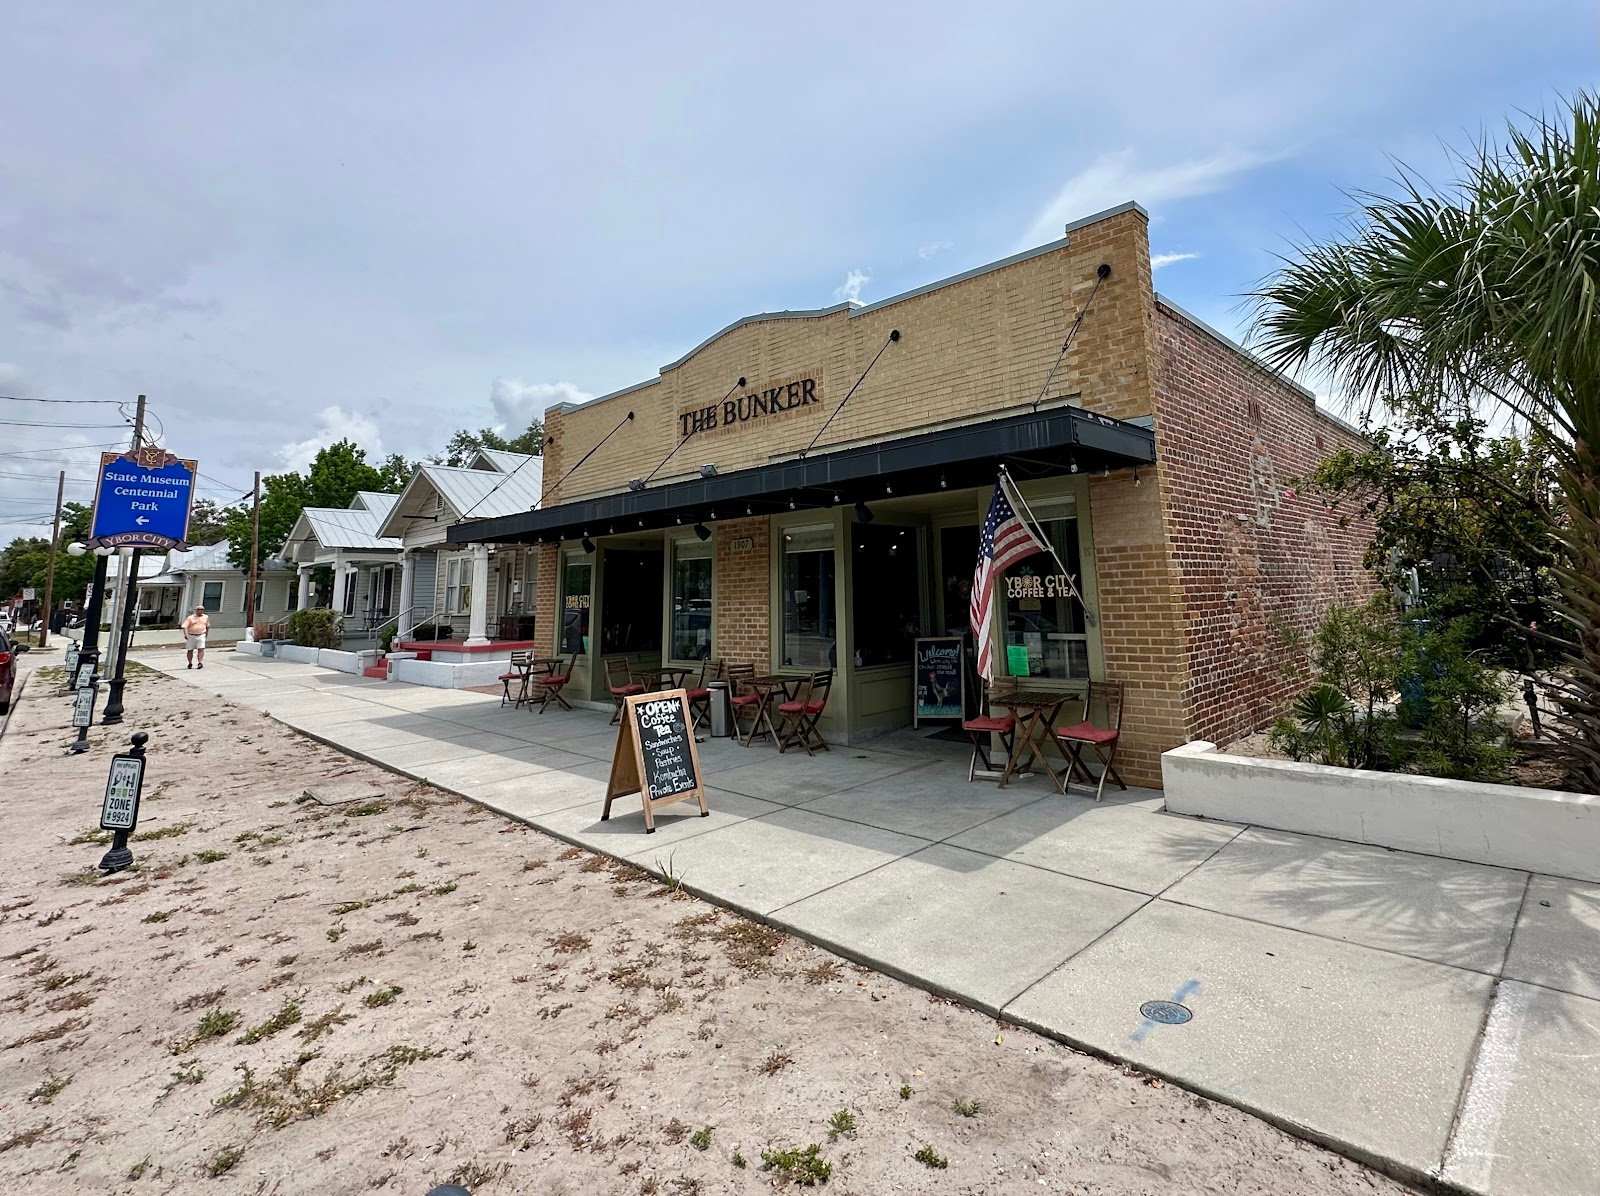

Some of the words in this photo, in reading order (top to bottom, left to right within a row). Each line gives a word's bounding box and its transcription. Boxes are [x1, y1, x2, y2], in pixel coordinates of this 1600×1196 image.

[680, 405, 718, 436] THE
[723, 378, 820, 425] BUNKER
[104, 472, 137, 482] State
[140, 475, 190, 486] Museum
[114, 487, 178, 499] Centennial
[131, 501, 159, 511] Park
[106, 534, 140, 546] YBOR
[143, 534, 173, 546] CITY
[734, 540, 749, 550] 1907
[1045, 574, 1077, 589] CITY
[1007, 588, 1045, 598] COFFEE
[1047, 587, 1055, 597] &
[1057, 587, 1077, 597] TEA
[645, 699, 677, 716] OPEN
[641, 713, 677, 728] Coffee
[653, 724, 673, 738] Tea
[645, 735, 683, 750] Sandwiches
[656, 746, 675, 757] Soup
[655, 755, 683, 769] Pastries
[653, 765, 687, 783] Kombucha
[649, 782, 673, 800] Private
[672, 776, 695, 792] Events
[109, 798, 131, 810] ZONE
